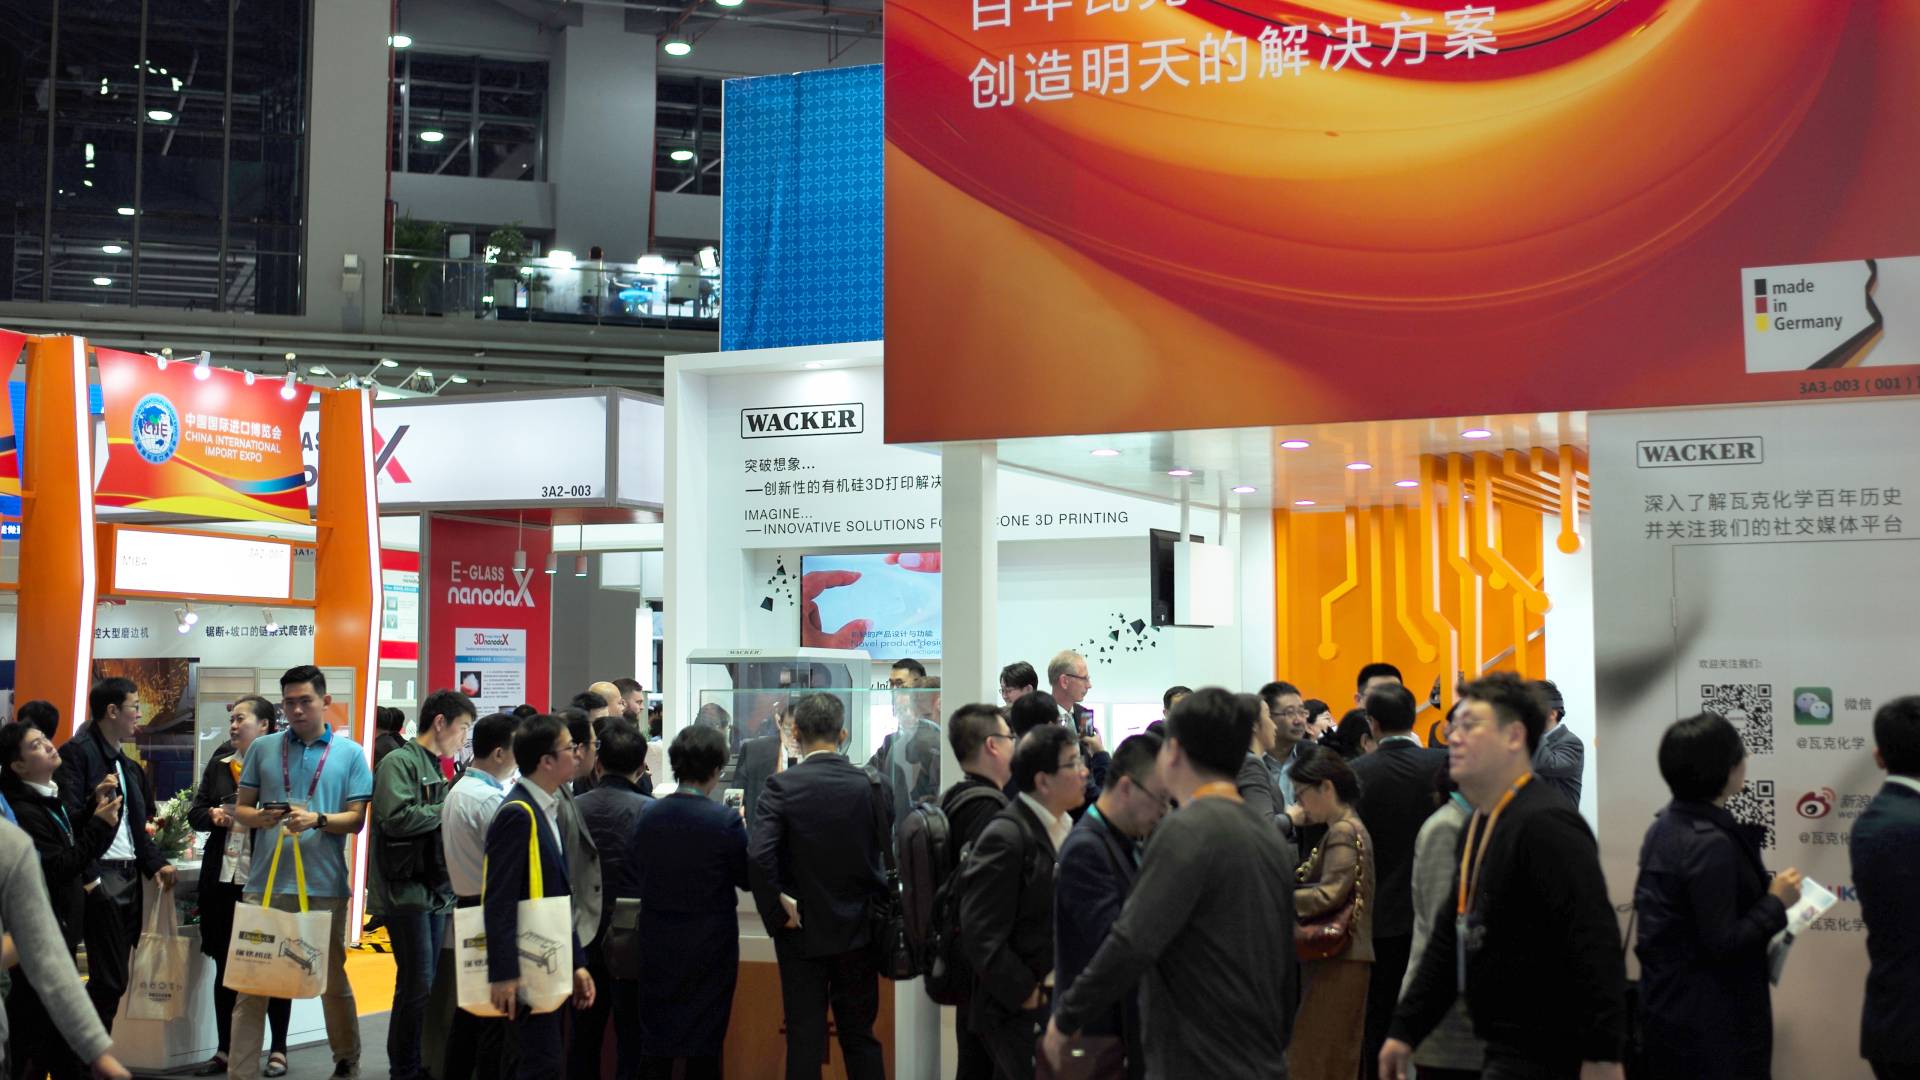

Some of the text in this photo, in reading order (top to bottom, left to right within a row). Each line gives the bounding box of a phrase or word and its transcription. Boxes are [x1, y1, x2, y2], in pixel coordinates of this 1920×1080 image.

[968, 4, 1499, 109] 创造明天的解决方案
[1773, 279, 1815, 295] made
[1773, 299, 1787, 313] in
[1774, 315, 1843, 332] Germany
[185, 412, 282, 440] 中国国际进口博览会
[746, 409, 856, 433] WACKER
[185, 431, 281, 453] CHINA INTERNATIONAL
[1642, 442, 1755, 463] WACKER
[205, 446, 262, 463] IMPORT EXPO
[541, 485, 591, 497] 3A2-003
[1644, 487, 1902, 513] 深入了解瓦克化学百年历史
[846, 518, 925, 532] SOLUTIONS
[1035, 513, 1053, 525] 3D
[1059, 511, 1128, 525] PRINTING
[1645, 515, 1902, 539] 并关注我们的社交媒体平台
[451, 561, 504, 582] E-GLASS
[1844, 698, 1872, 711] 微信
[1796, 737, 1865, 751] @瓦克化学
